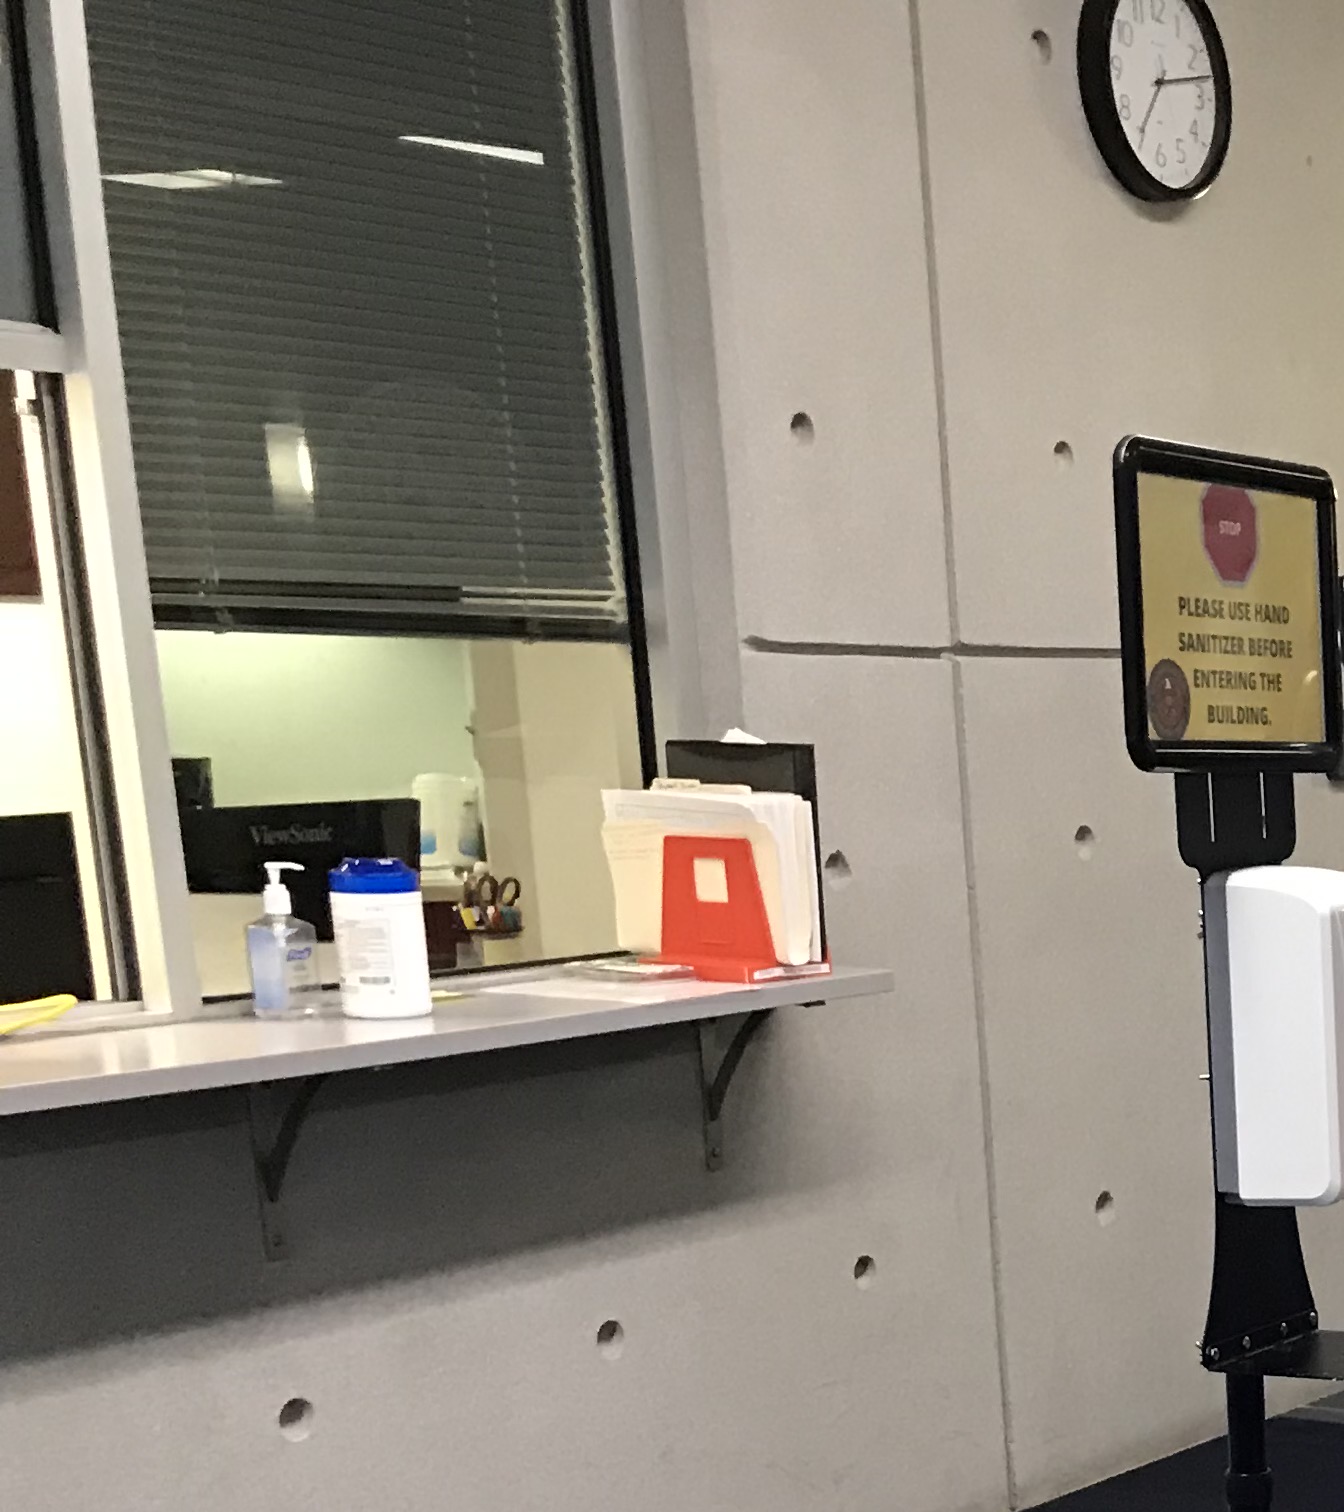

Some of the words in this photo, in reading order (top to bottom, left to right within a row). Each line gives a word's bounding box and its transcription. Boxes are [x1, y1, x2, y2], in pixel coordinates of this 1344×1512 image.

[1218, 520, 1242, 537] STOP
[1178, 596, 1226, 621] PLEASE
[1227, 602, 1252, 622] USE
[1254, 604, 1291, 626] HAND
[1178, 631, 1246, 656] SANITIZER
[1247, 637, 1293, 659] BEFORE
[1193, 669, 1257, 693] ENTERING
[1258, 672, 1283, 692] THE
[1207, 705, 1273, 727] BUILDING.
